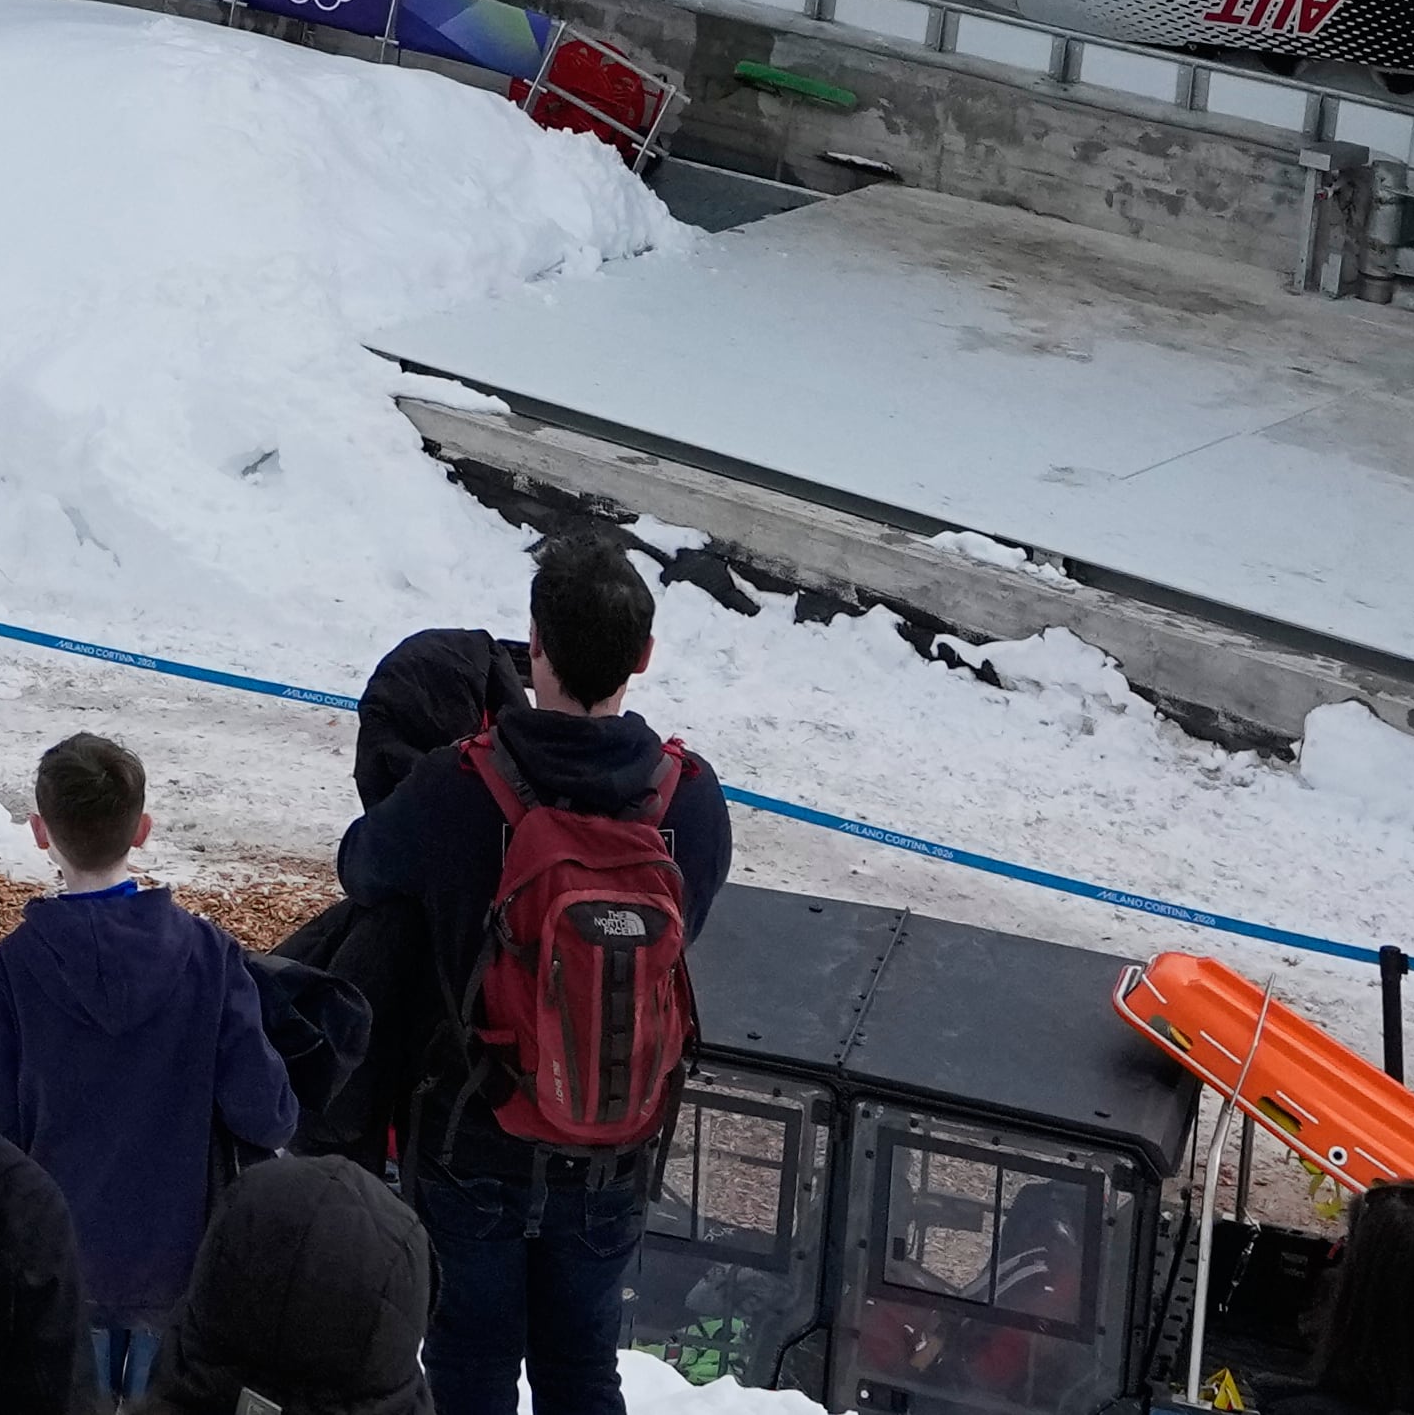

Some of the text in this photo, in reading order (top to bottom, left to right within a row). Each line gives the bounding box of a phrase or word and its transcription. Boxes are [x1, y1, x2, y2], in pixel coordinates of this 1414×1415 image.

[324, 696, 358, 709] CORTIN
[839, 822, 954, 859] MILANO CORTINA 2026
[1096, 890, 1143, 907] MILANO
[1144, 902, 1192, 921] CORTINA
[608, 910, 626, 919] THE
[594, 916, 627, 927] NORTH
[604, 925, 630, 936] FACE
